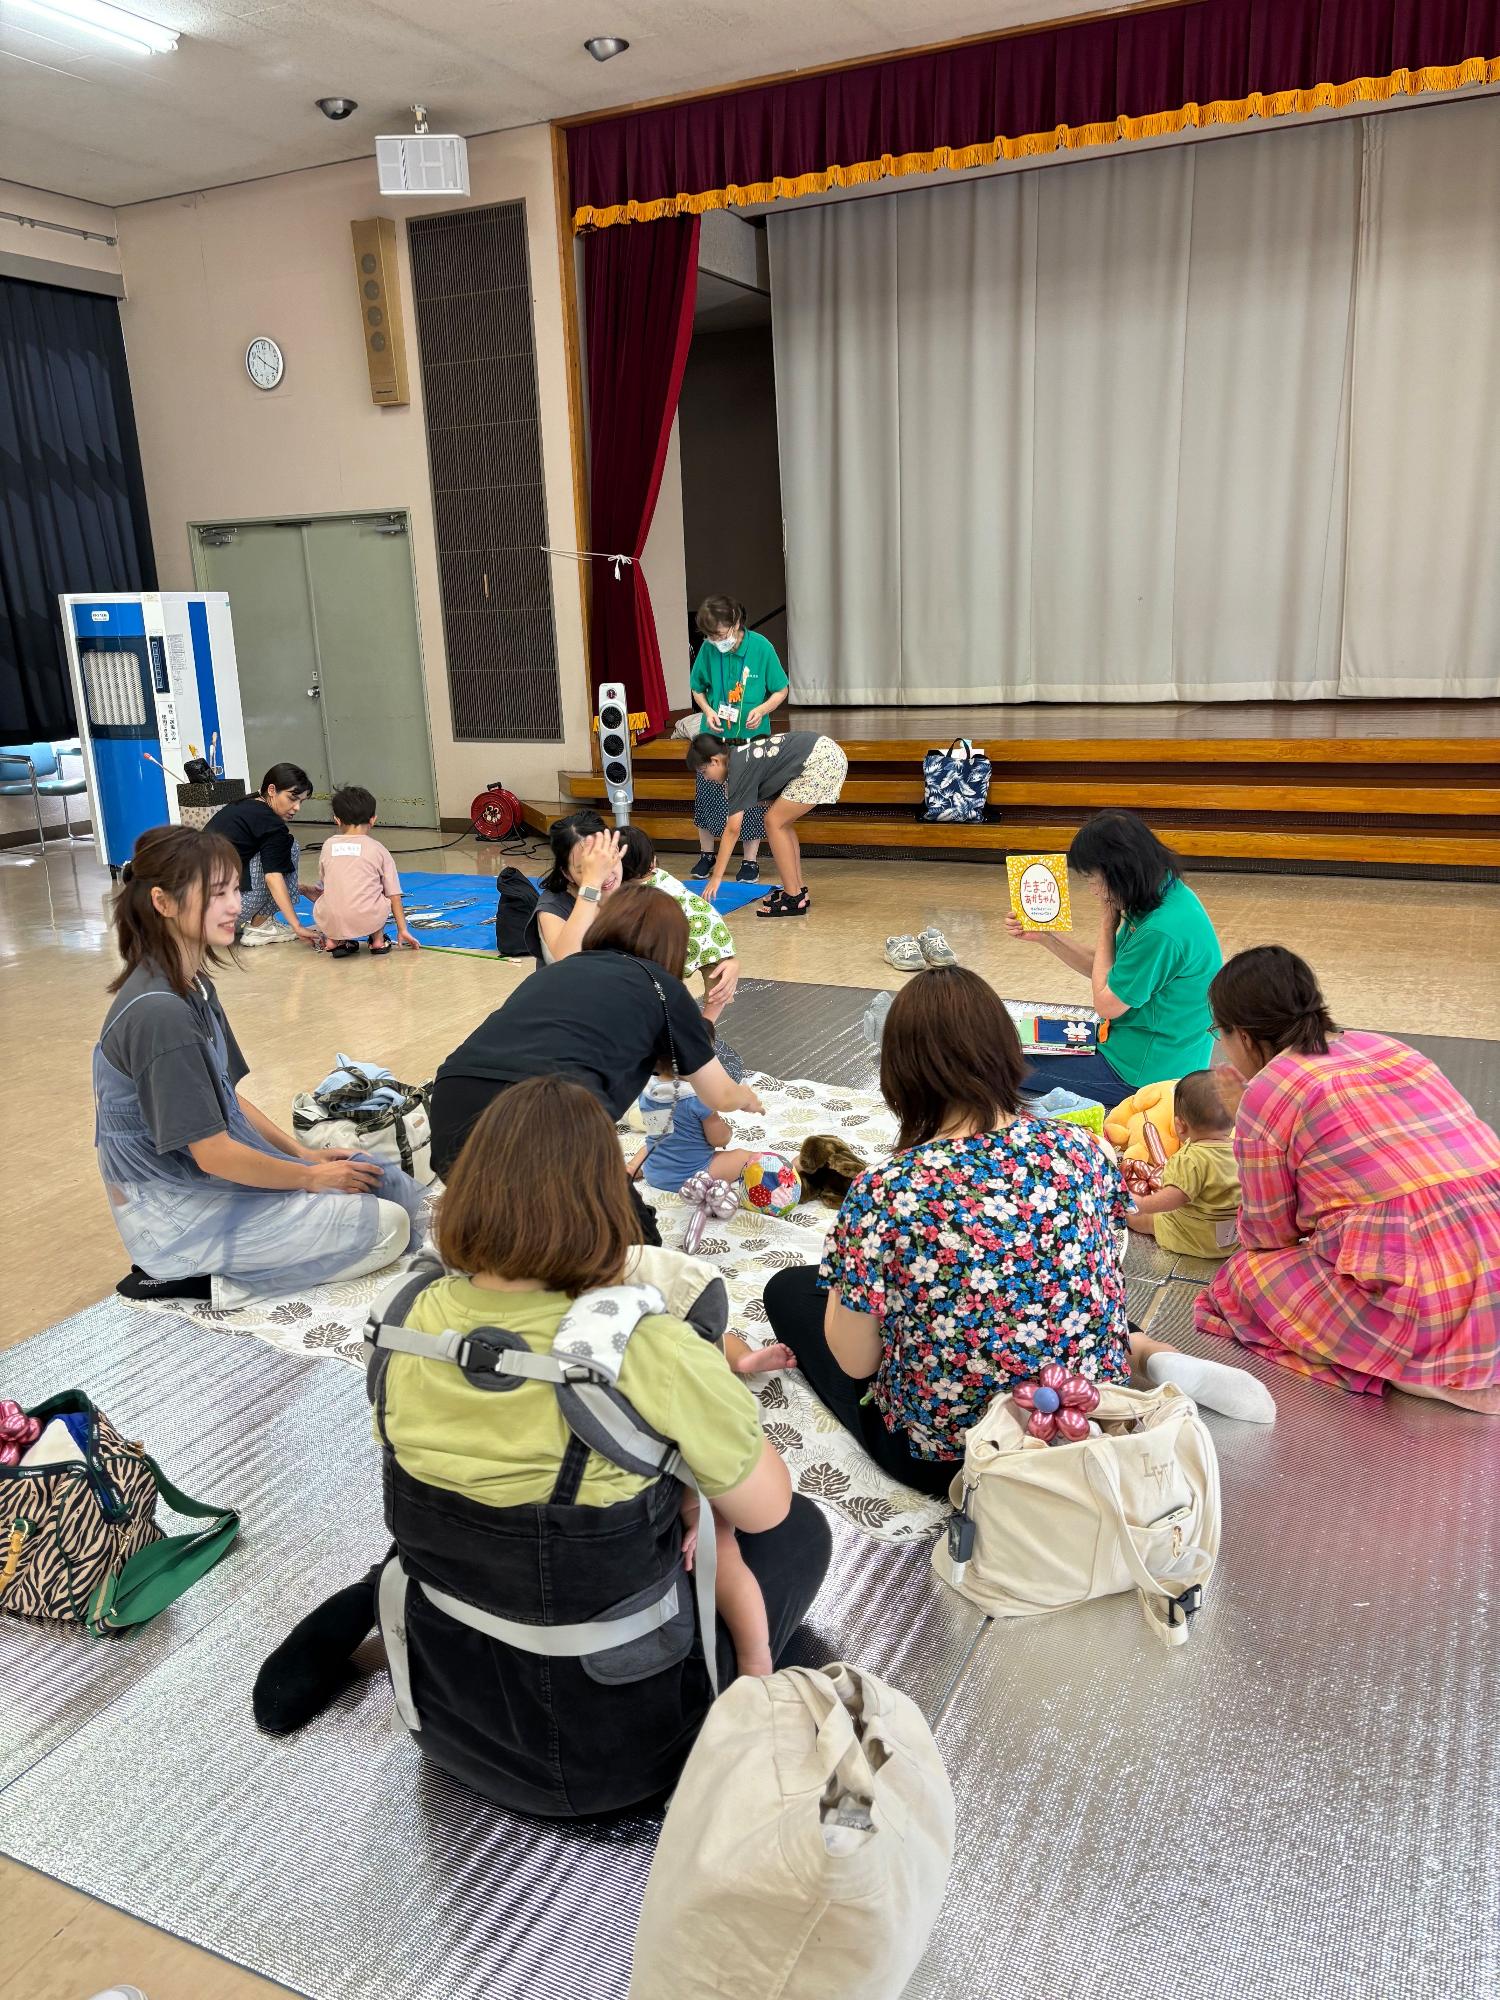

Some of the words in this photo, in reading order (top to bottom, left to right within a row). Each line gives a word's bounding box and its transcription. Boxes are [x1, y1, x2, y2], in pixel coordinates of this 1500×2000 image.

[1023, 878, 1056, 893] たまごの
[1024, 894, 1056, 905] あかちゃん
